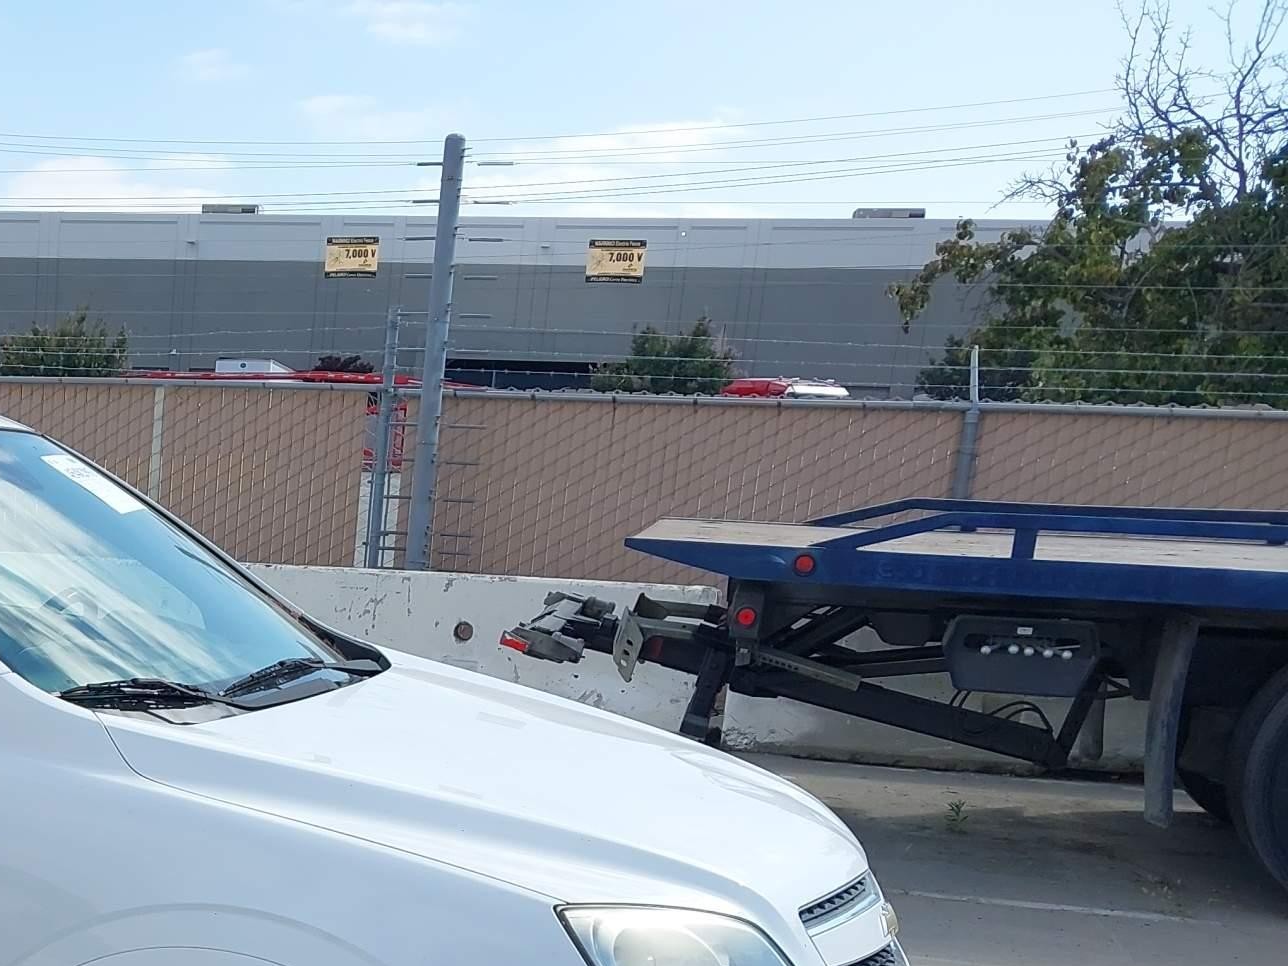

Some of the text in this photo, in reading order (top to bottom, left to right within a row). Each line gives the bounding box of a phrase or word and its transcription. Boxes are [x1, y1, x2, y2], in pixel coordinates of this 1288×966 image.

[344, 248, 376, 259] 7,000 V
[608, 252, 643, 263] 7,000 V
